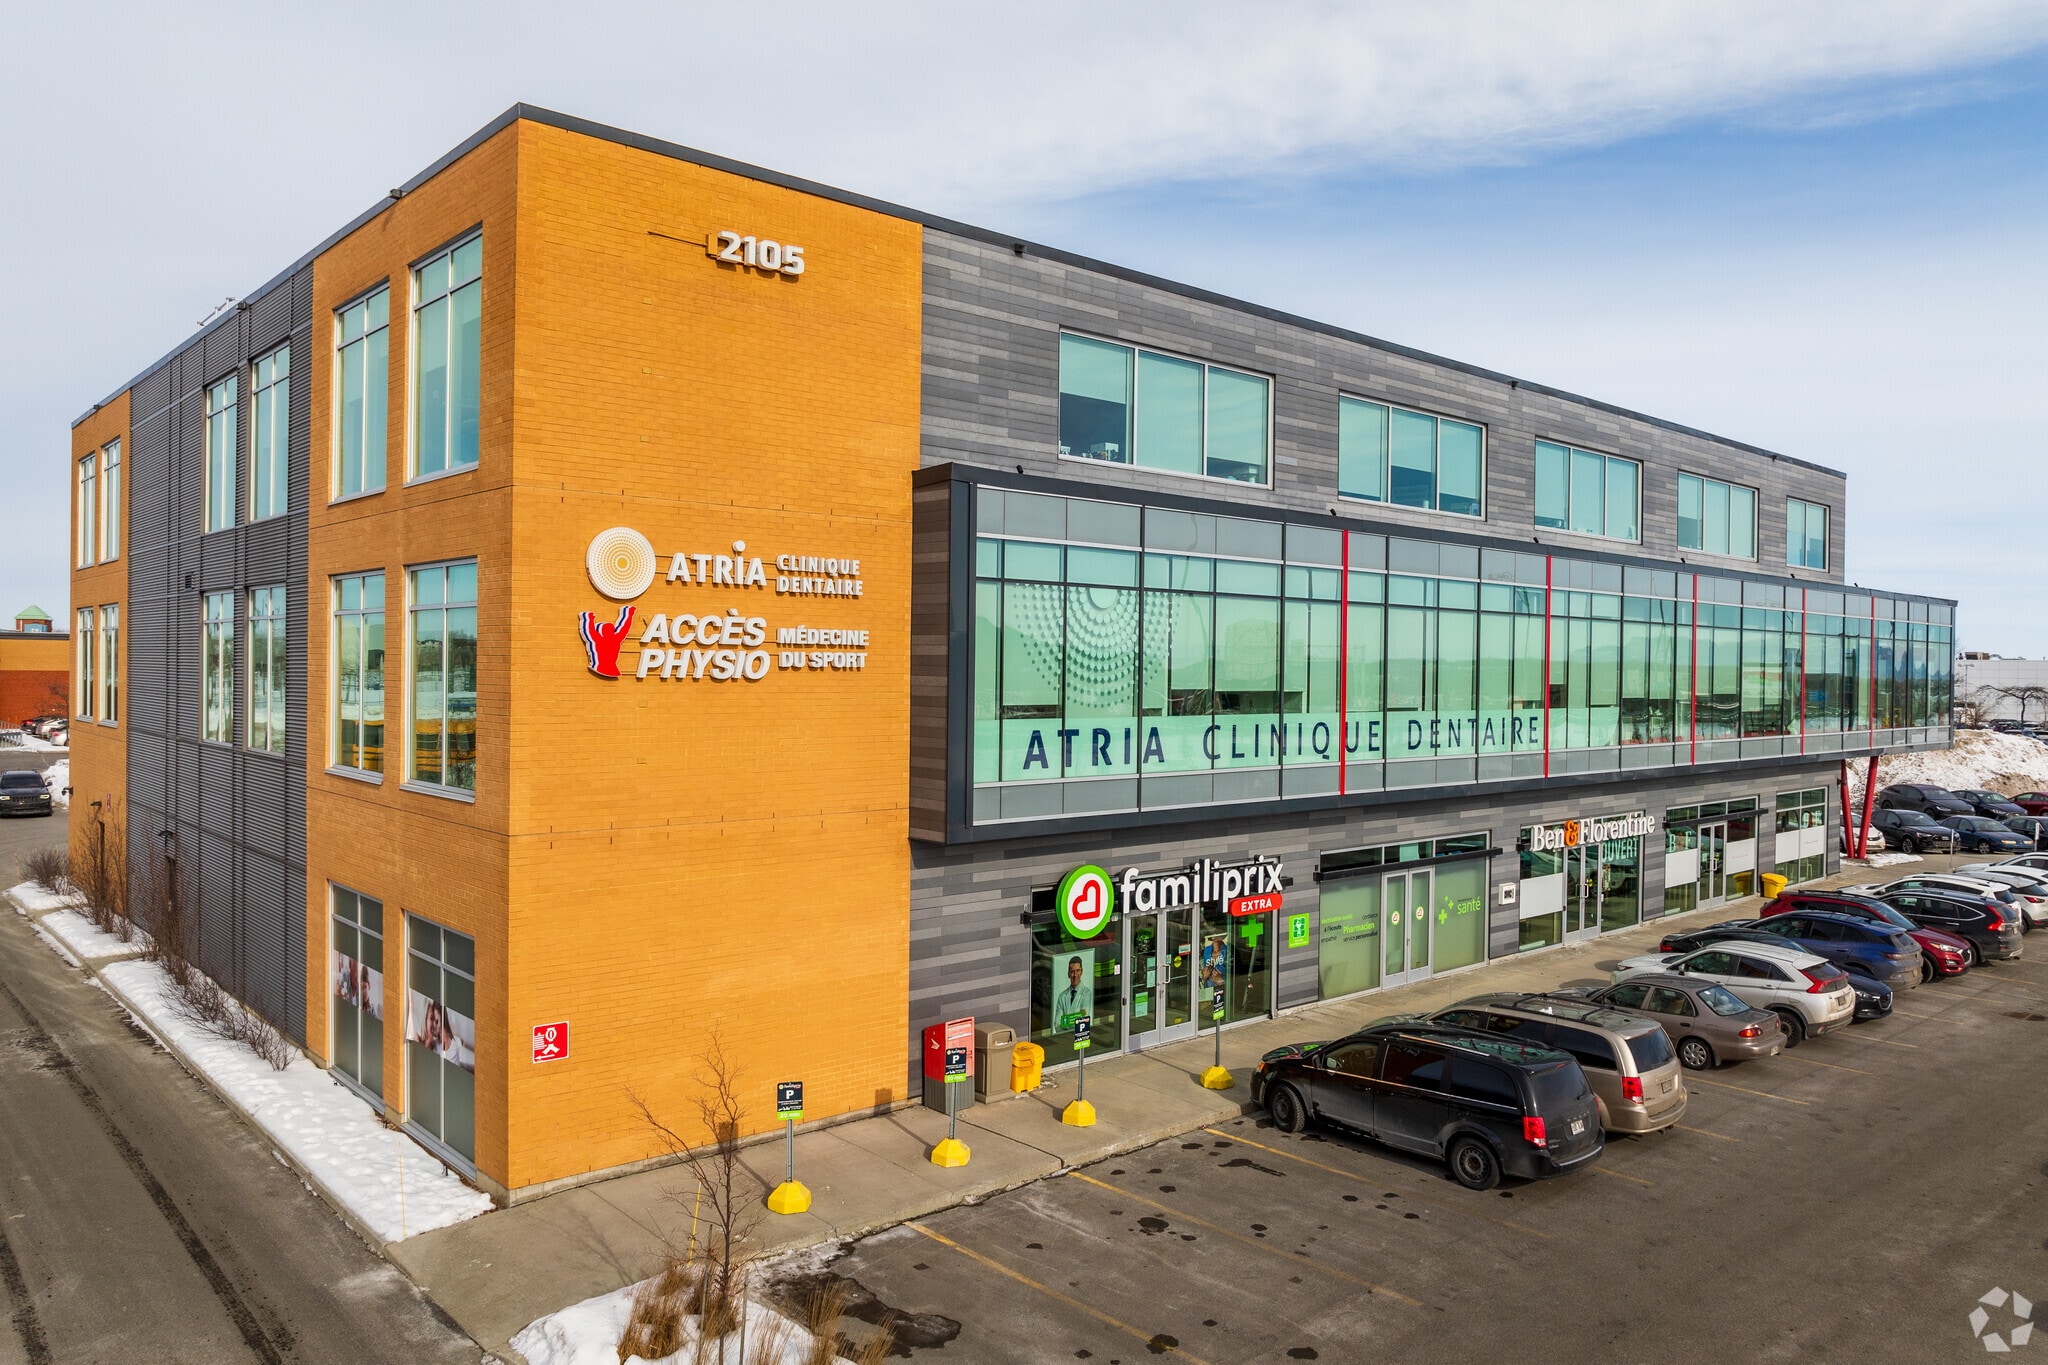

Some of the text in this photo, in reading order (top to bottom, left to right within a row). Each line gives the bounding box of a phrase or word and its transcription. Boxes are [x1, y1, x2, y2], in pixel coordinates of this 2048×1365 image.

[717, 230, 805, 276] 2105
[666, 540, 767, 586] ATRIA
[776, 554, 860, 577] CLINIQUE
[776, 576, 863, 596] DENTAIRE
[640, 608, 767, 647] ACCÈS
[776, 624, 870, 646] MÉDECINE
[636, 648, 771, 680] PHYSIO
[778, 652, 868, 669] DU SPORT
[1022, 716, 1539, 770] ATRIA CLINIQUE DENTAIRE
[1601, 837, 1639, 863] OUVERT
[1121, 854, 1284, 914] familiprix
[1241, 897, 1273, 913] EXTRA
[1457, 896, 1482, 915] santé
[1079, 1023, 1086, 1033] P
[952, 1055, 960, 1064] P
[786, 1090, 795, 1099] P
